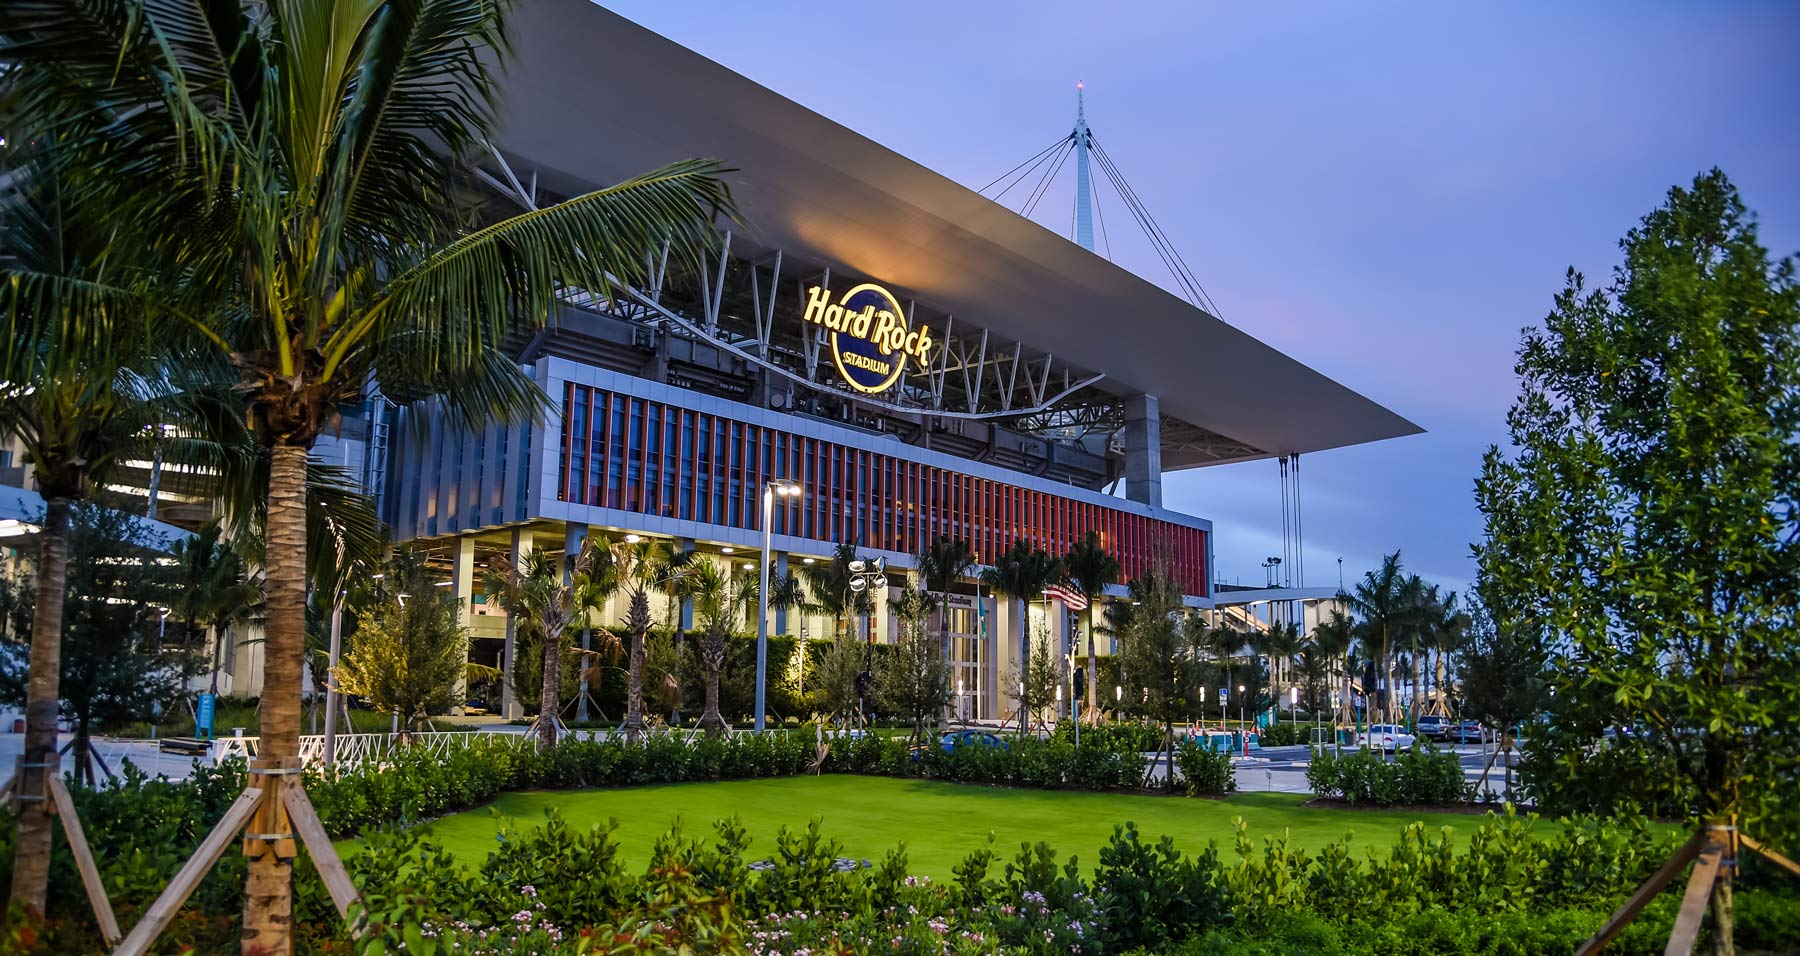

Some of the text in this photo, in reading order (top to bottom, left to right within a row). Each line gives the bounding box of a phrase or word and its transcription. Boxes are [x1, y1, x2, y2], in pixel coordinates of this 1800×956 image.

[804, 286, 932, 366] Hard Rock
[843, 352, 890, 376] STADIUM
